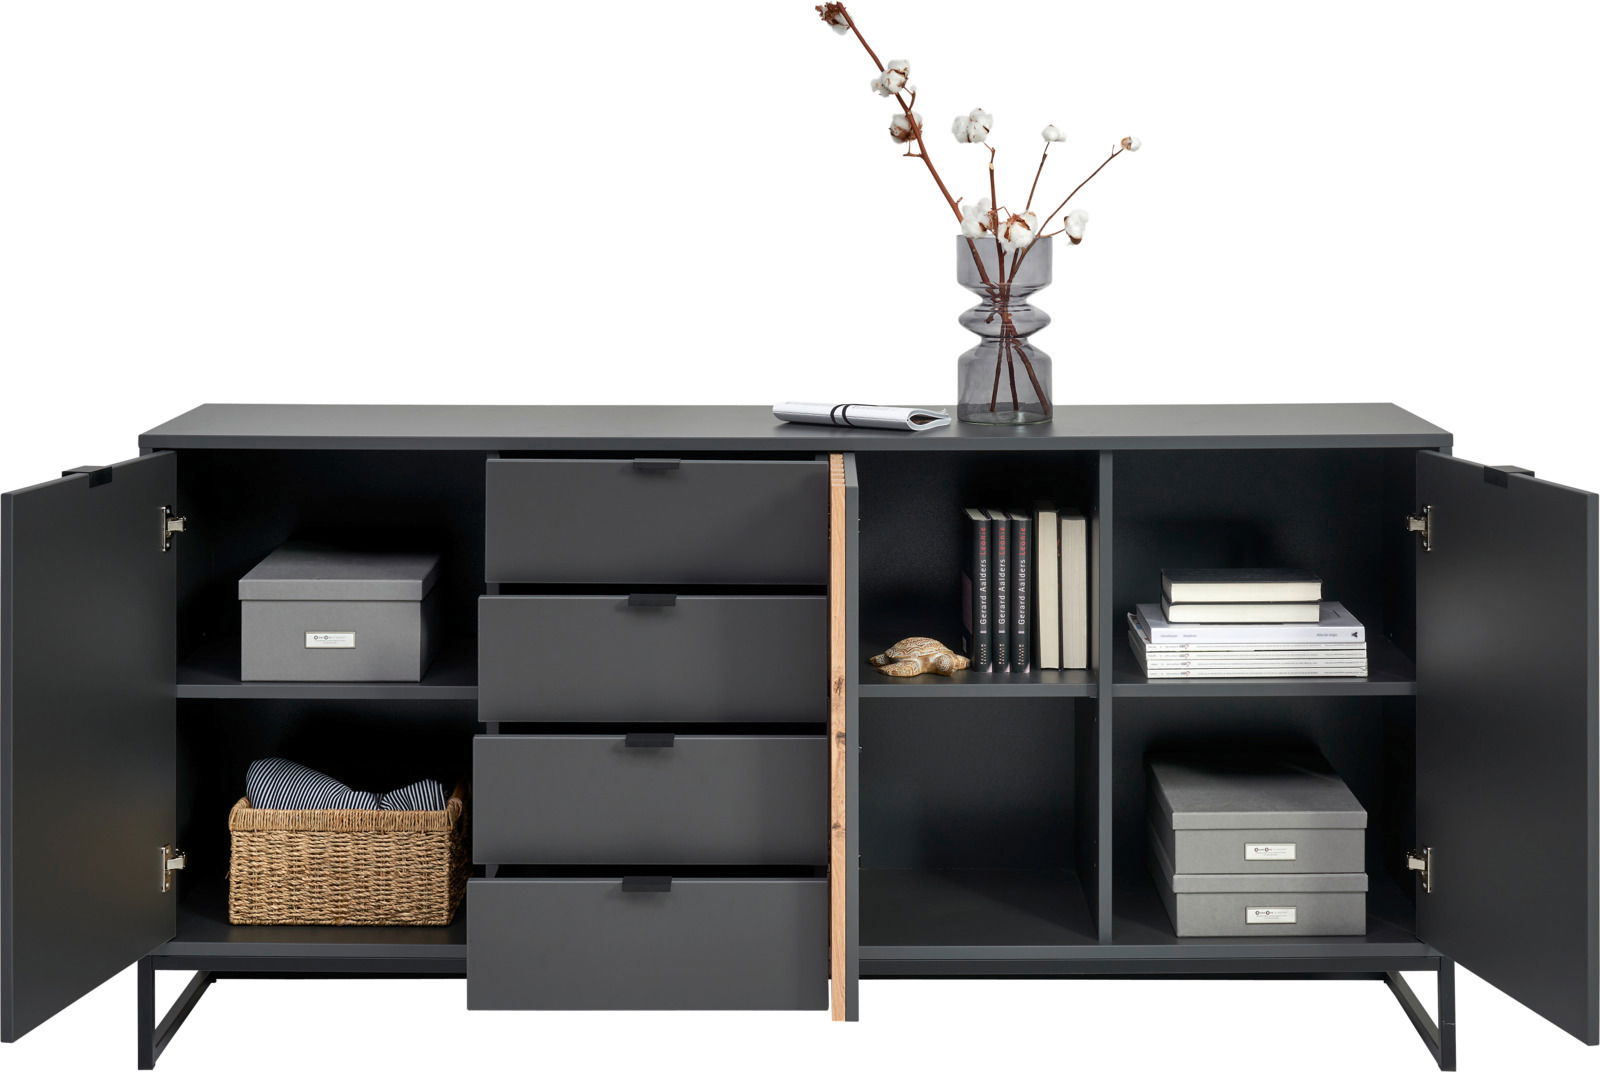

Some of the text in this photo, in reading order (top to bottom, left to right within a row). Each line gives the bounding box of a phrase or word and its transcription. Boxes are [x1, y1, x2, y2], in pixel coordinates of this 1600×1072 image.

[979, 559, 987, 592] Aalders
[998, 559, 1006, 592] Aalders
[1018, 559, 1026, 592] Aalders
[979, 595, 987, 625] Gerard
[998, 595, 1006, 625] Gerard
[1018, 595, 1026, 625] Gerard
